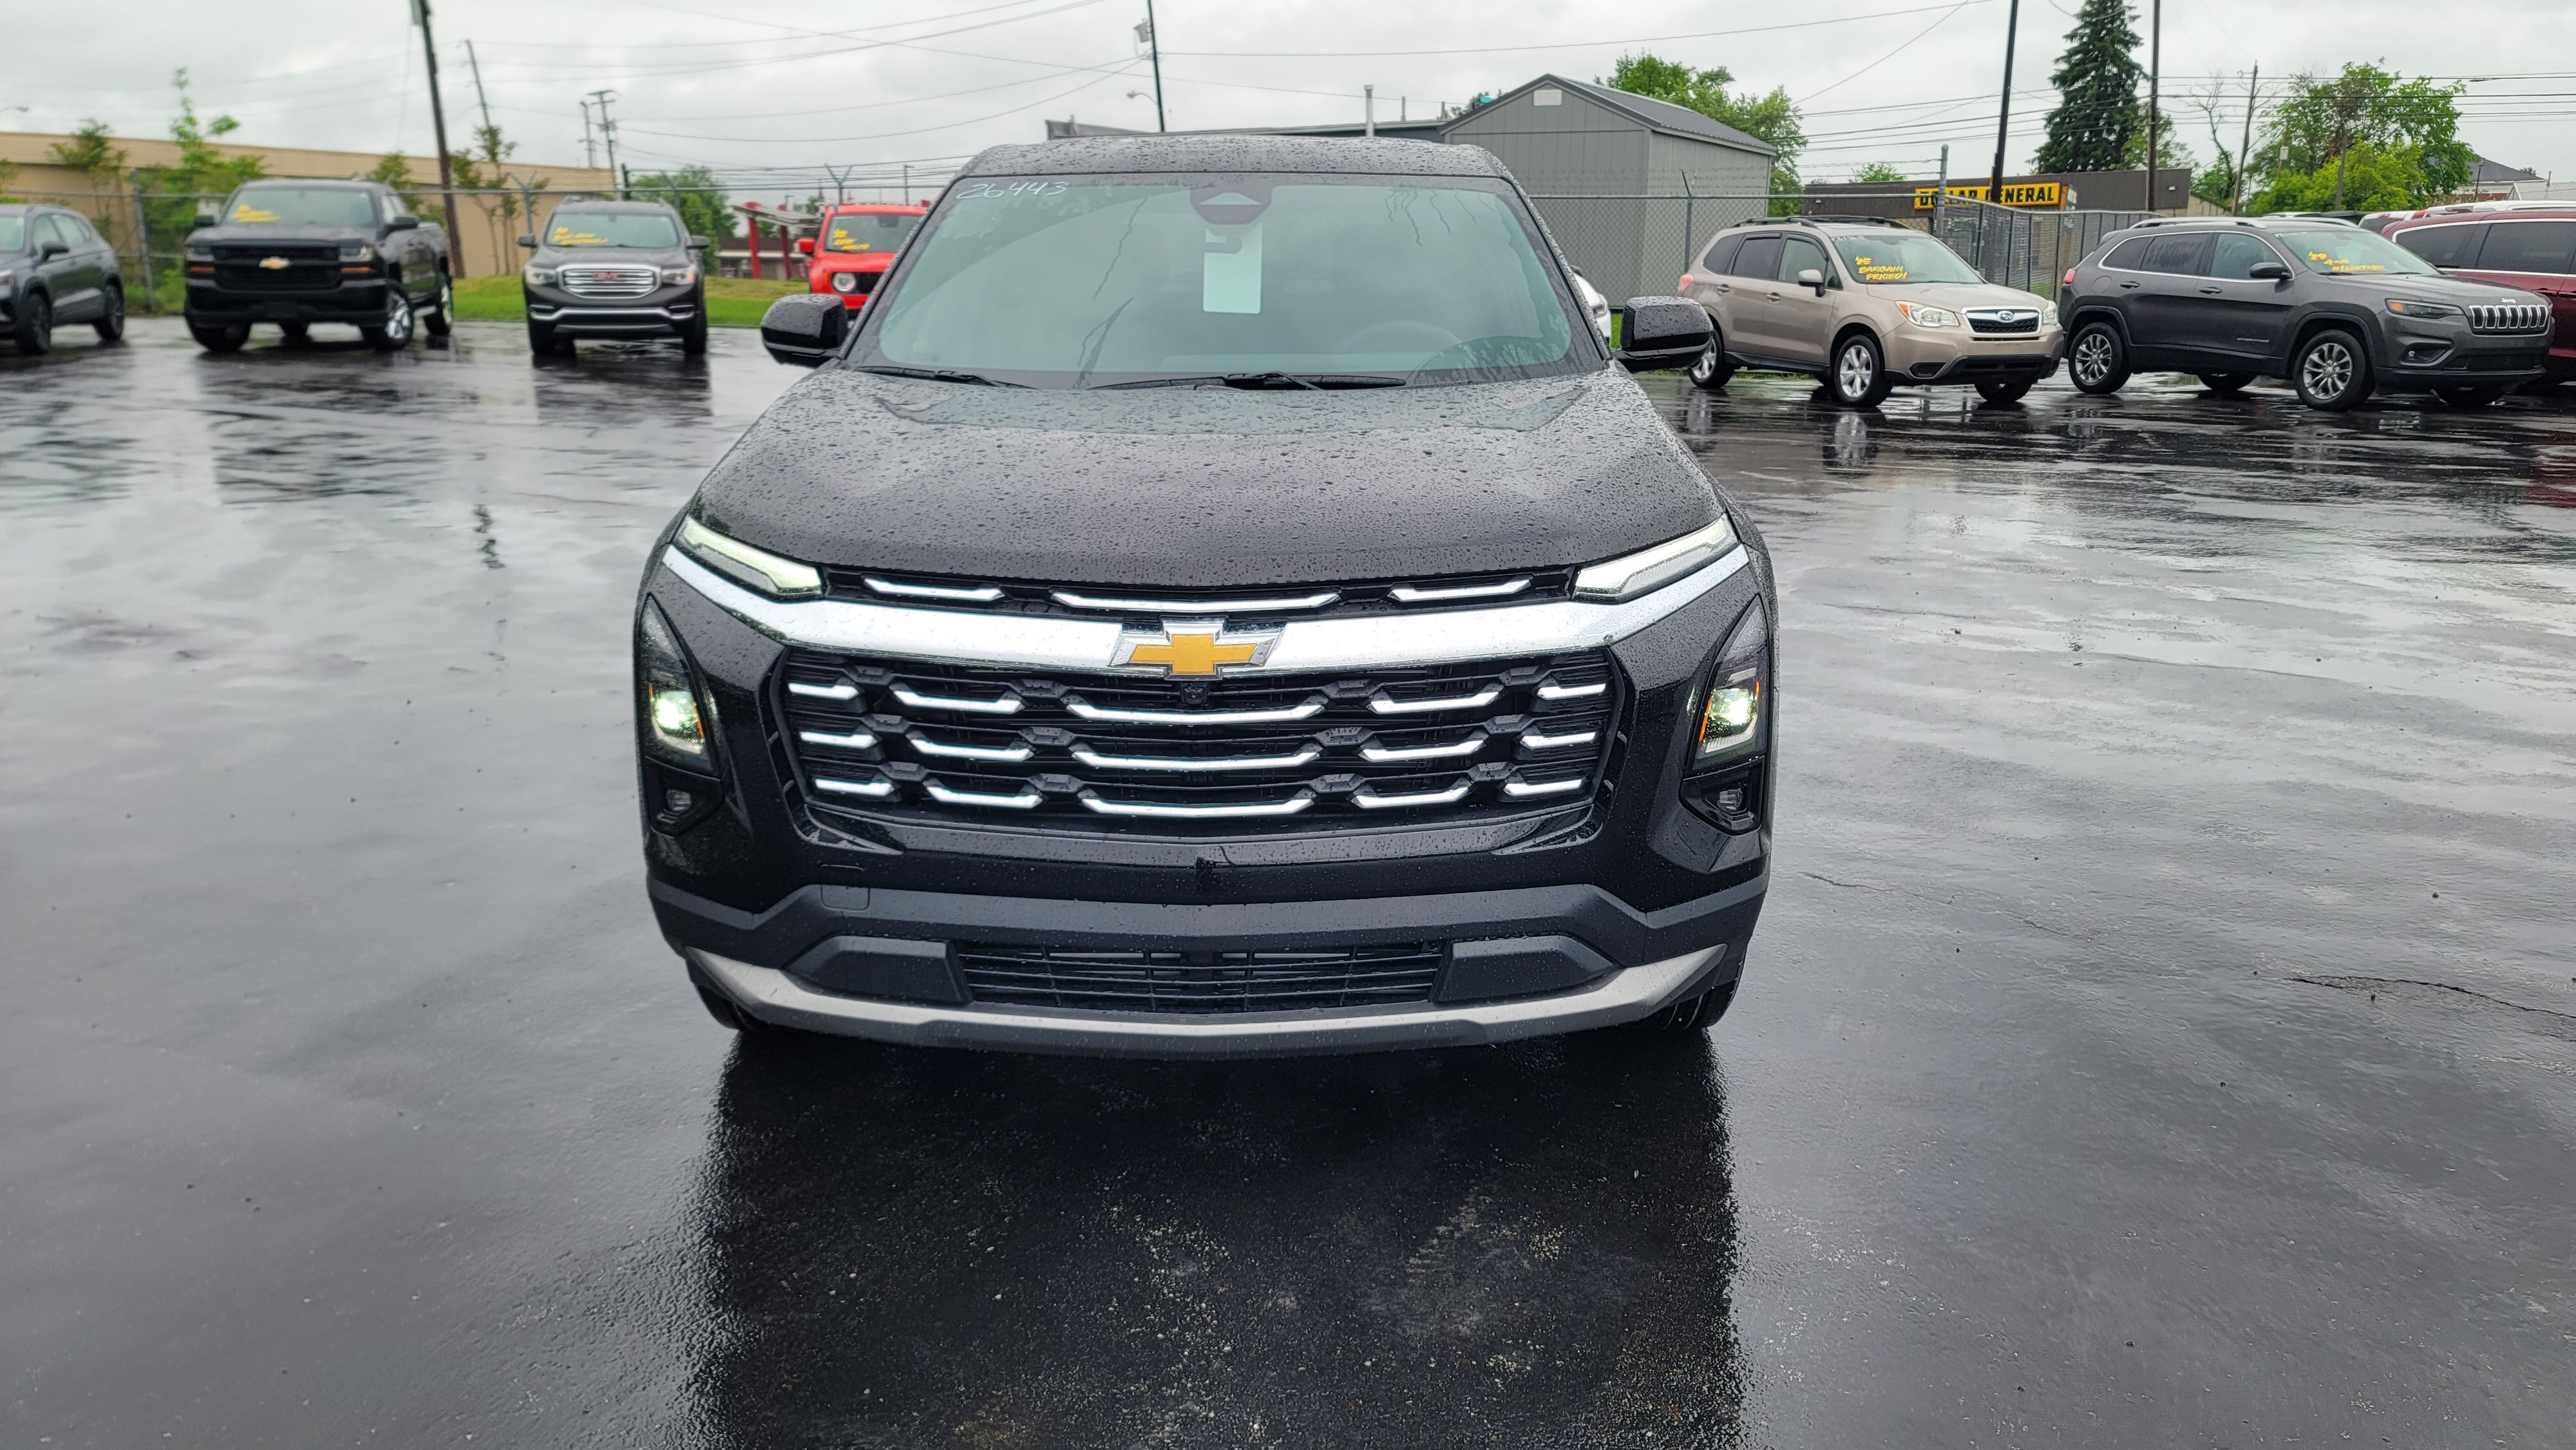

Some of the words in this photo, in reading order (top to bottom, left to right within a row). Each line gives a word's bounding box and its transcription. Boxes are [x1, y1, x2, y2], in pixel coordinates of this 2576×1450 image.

[956, 182, 1069, 199] 26443
[1985, 186, 2054, 205] GNERAL
[1866, 272, 1909, 280] PRICED!
